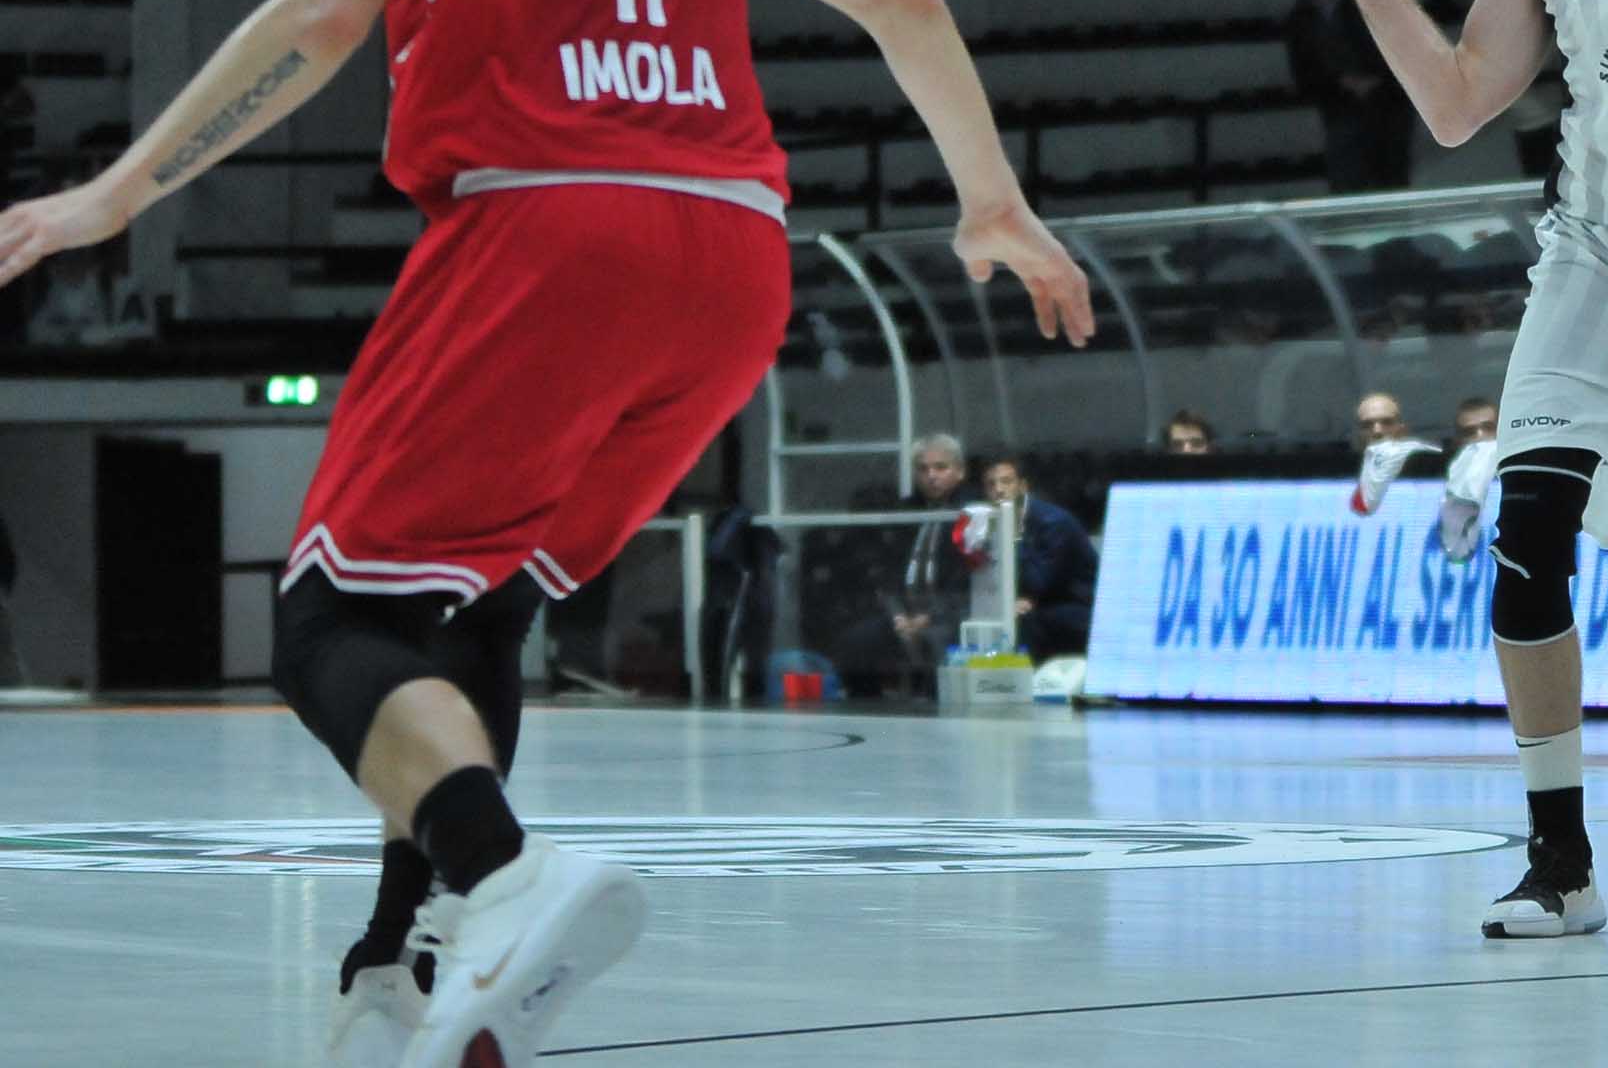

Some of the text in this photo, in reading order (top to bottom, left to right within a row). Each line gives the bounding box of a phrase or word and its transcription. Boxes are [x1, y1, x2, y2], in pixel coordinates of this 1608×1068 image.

[559, 39, 727, 111] IMOLA
[1153, 526, 1203, 648] DA
[1263, 526, 1361, 649] ANNI
[1357, 526, 1402, 649] AL
